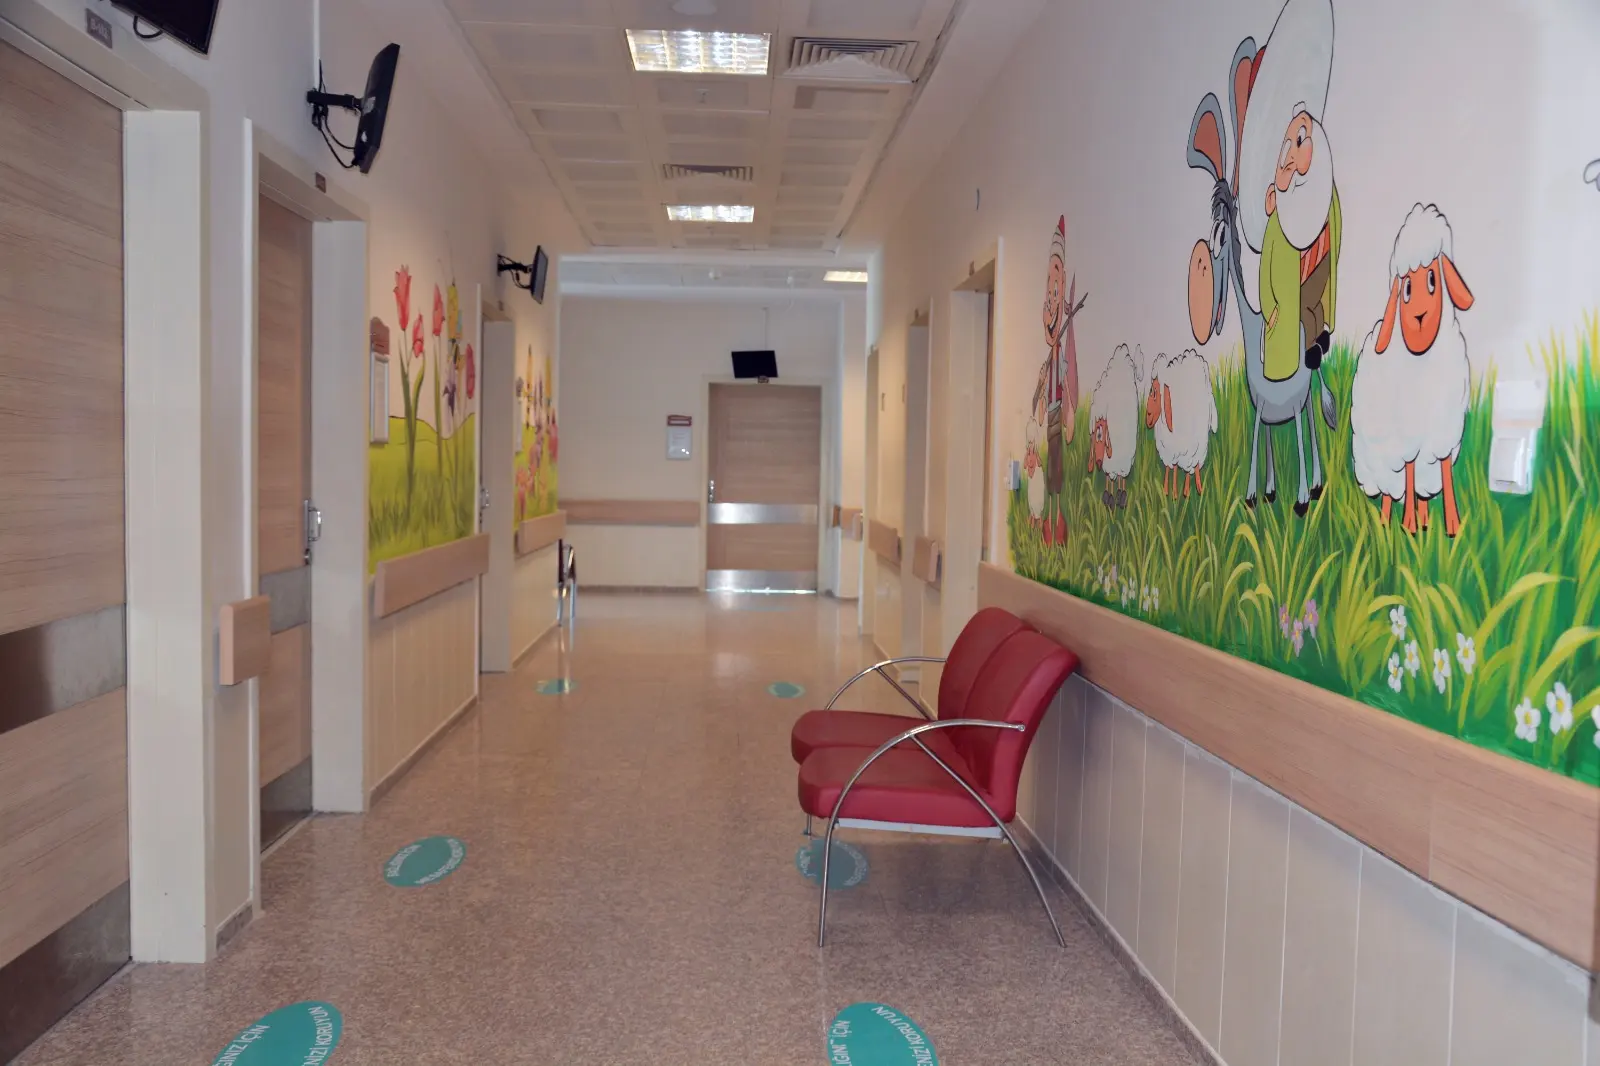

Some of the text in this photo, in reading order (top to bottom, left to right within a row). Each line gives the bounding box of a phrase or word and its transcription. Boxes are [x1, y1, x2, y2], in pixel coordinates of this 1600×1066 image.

[301, 1006, 333, 1066] NİZİ KORUYUN
[871, 1006, 924, 1047] KORUYUN
